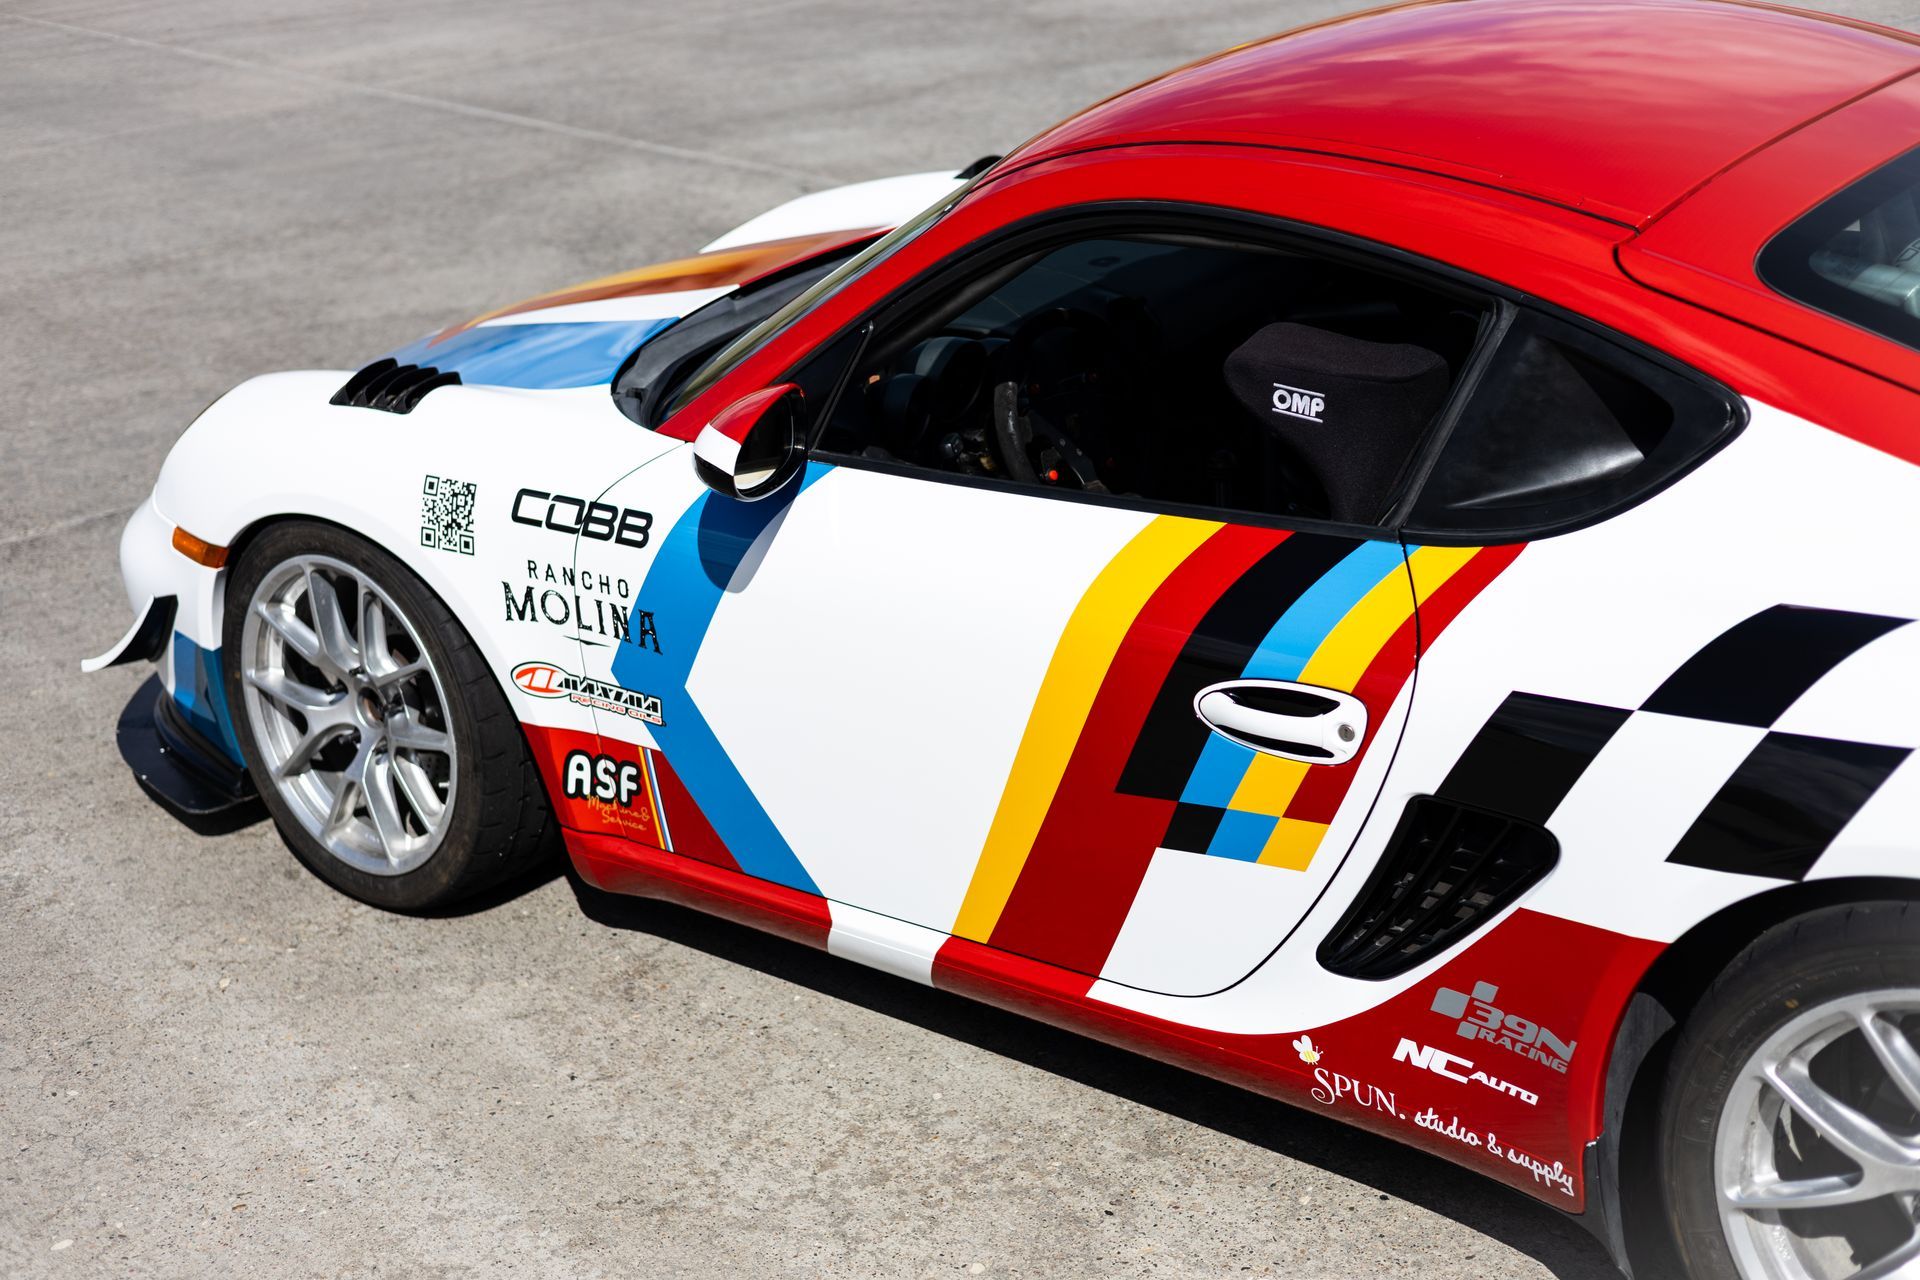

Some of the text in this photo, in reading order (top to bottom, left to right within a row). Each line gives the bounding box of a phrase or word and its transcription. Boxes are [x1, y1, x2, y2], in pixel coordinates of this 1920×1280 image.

[1272, 389, 1325, 417] OMP
[511, 488, 653, 549] COBB
[527, 559, 629, 598] RANCHO
[501, 581, 663, 655] MOLINA
[557, 677, 662, 715] MAXIMA
[571, 694, 662, 725] RACING OILS
[566, 754, 638, 804] ASF
[602, 808, 647, 831] Service
[1466, 1000, 1577, 1061] 39N
[1477, 1028, 1568, 1074] RACING
[1414, 1107, 1574, 1197] studio & supply
